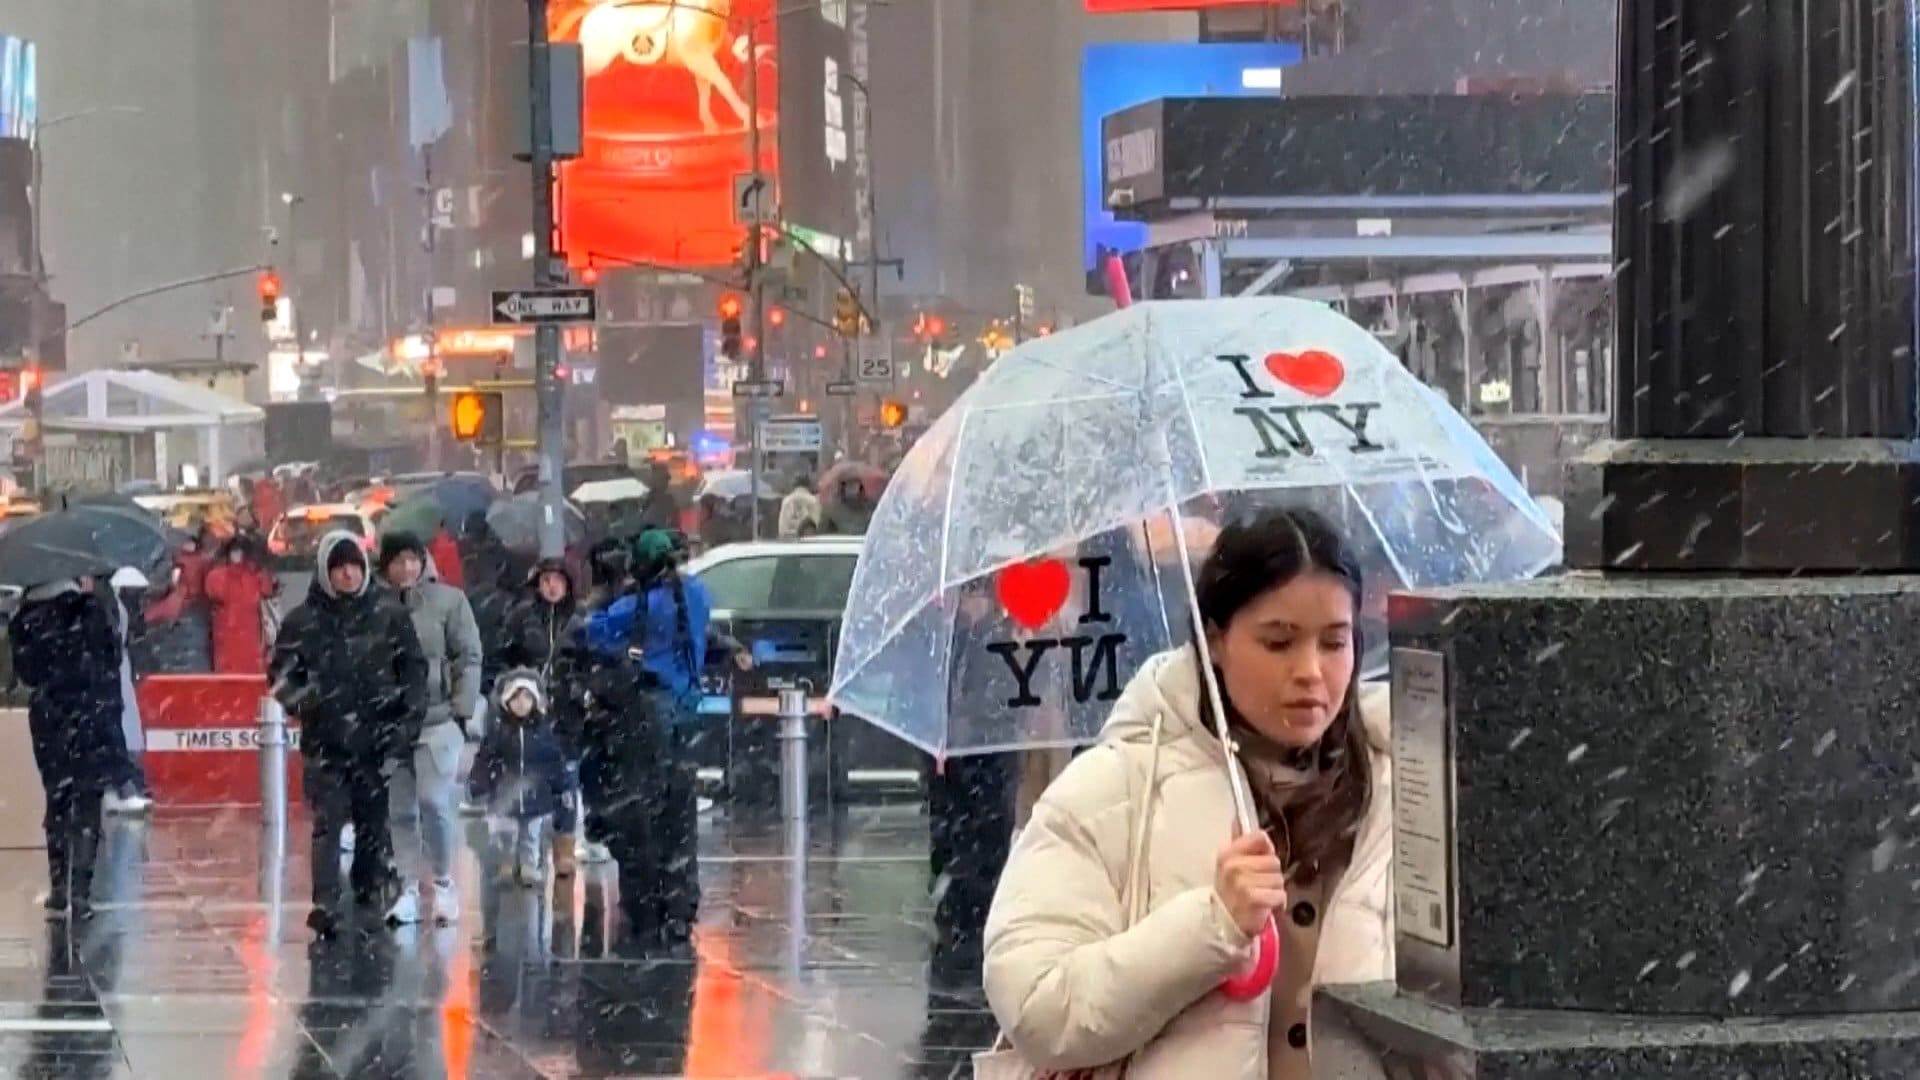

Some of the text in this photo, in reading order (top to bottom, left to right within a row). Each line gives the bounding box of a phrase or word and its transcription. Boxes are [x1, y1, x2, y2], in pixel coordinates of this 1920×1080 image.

[508, 298, 582, 314] ONE WAY
[863, 358, 889, 377] 25
[1216, 354, 1275, 398] I
[1233, 401, 1385, 458] NY
[175, 731, 233, 747] TIMES
